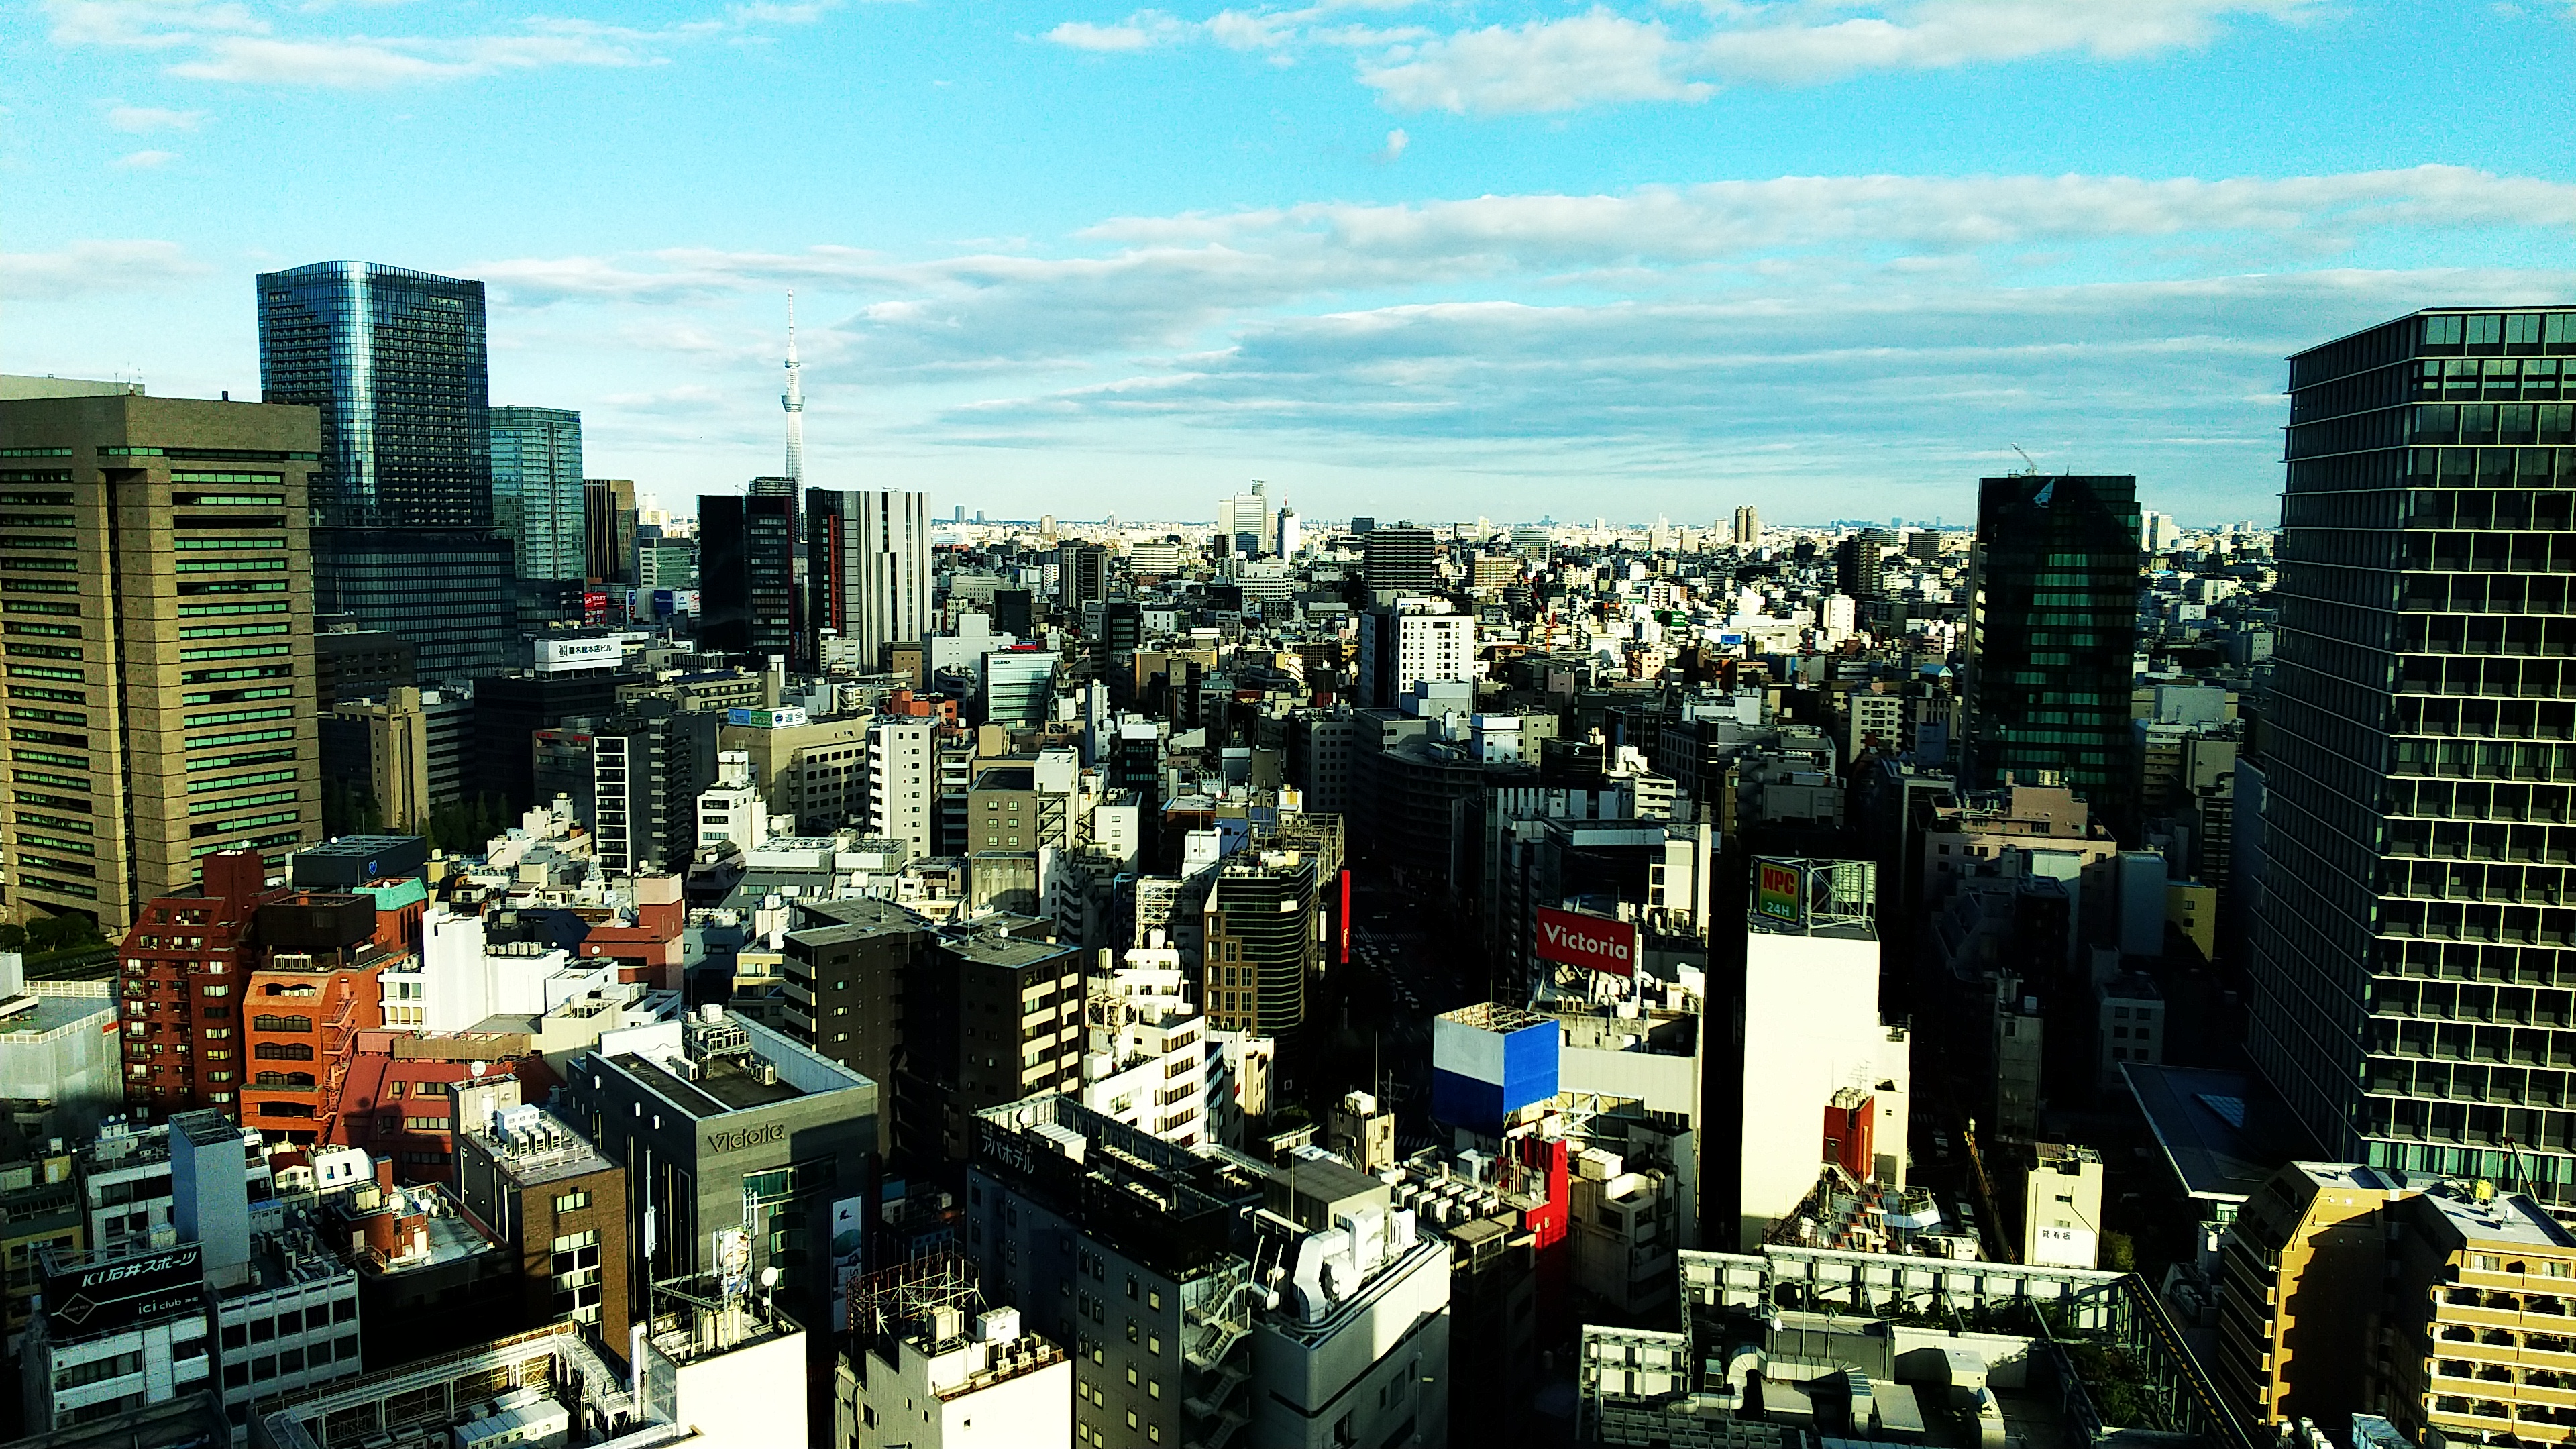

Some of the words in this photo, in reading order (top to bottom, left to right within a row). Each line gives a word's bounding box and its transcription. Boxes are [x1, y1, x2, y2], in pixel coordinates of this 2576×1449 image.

[1763, 867, 1795, 895] NPC
[1766, 902, 1790, 917] 24H
[1543, 922, 1628, 960] Victoria
[707, 1124, 784, 1152] Victoria
[981, 1134, 1034, 1175] アパホテル
[81, 1271, 105, 1287] ICI
[105, 1251, 197, 1283] 石井スポーツ
[138, 1299, 156, 1315] ici
[159, 1298, 182, 1310] club
